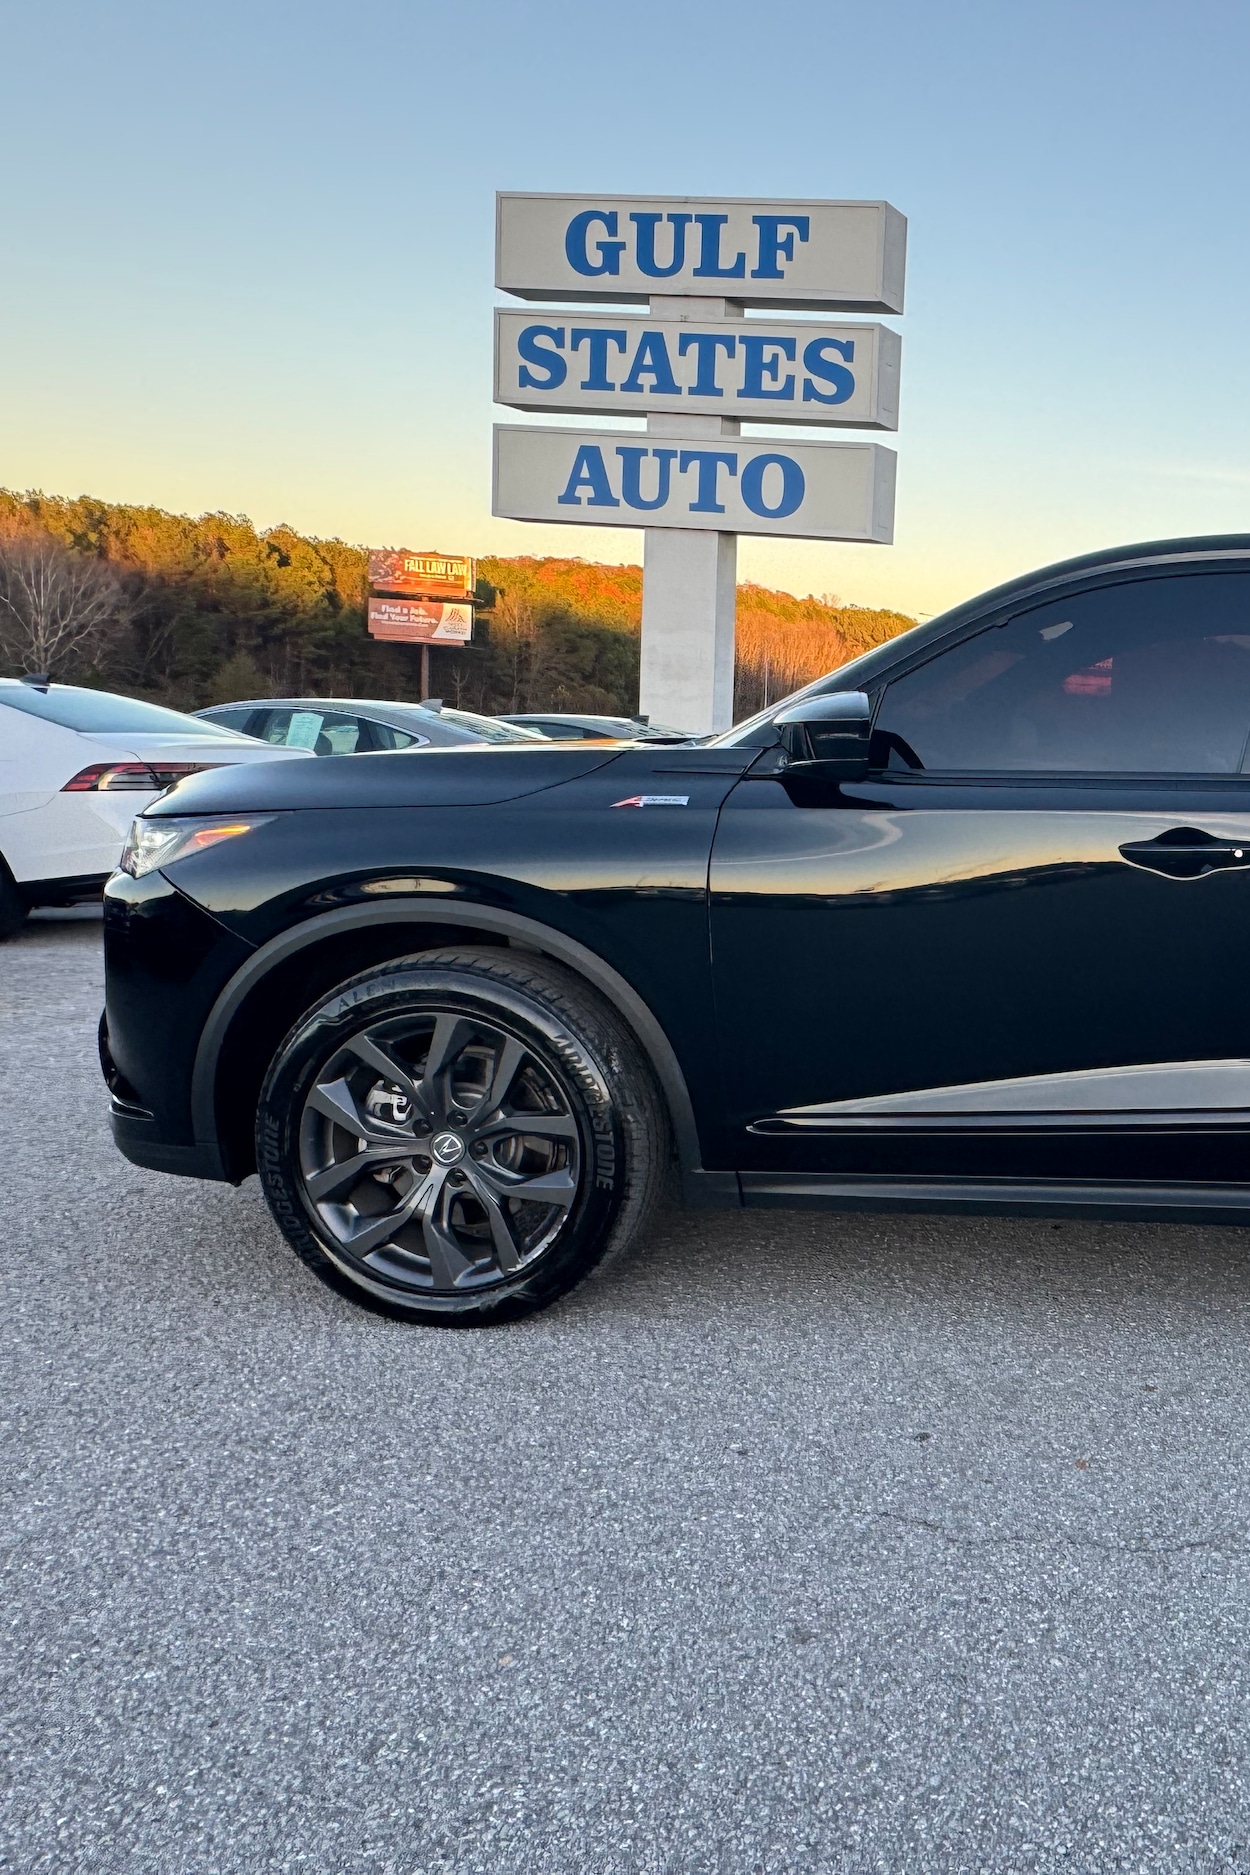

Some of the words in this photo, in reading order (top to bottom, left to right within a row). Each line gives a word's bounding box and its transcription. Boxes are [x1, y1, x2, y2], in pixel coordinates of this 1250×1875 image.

[565, 210, 810, 279] GULF
[517, 325, 856, 405] STATES
[557, 445, 806, 519] AUTO
